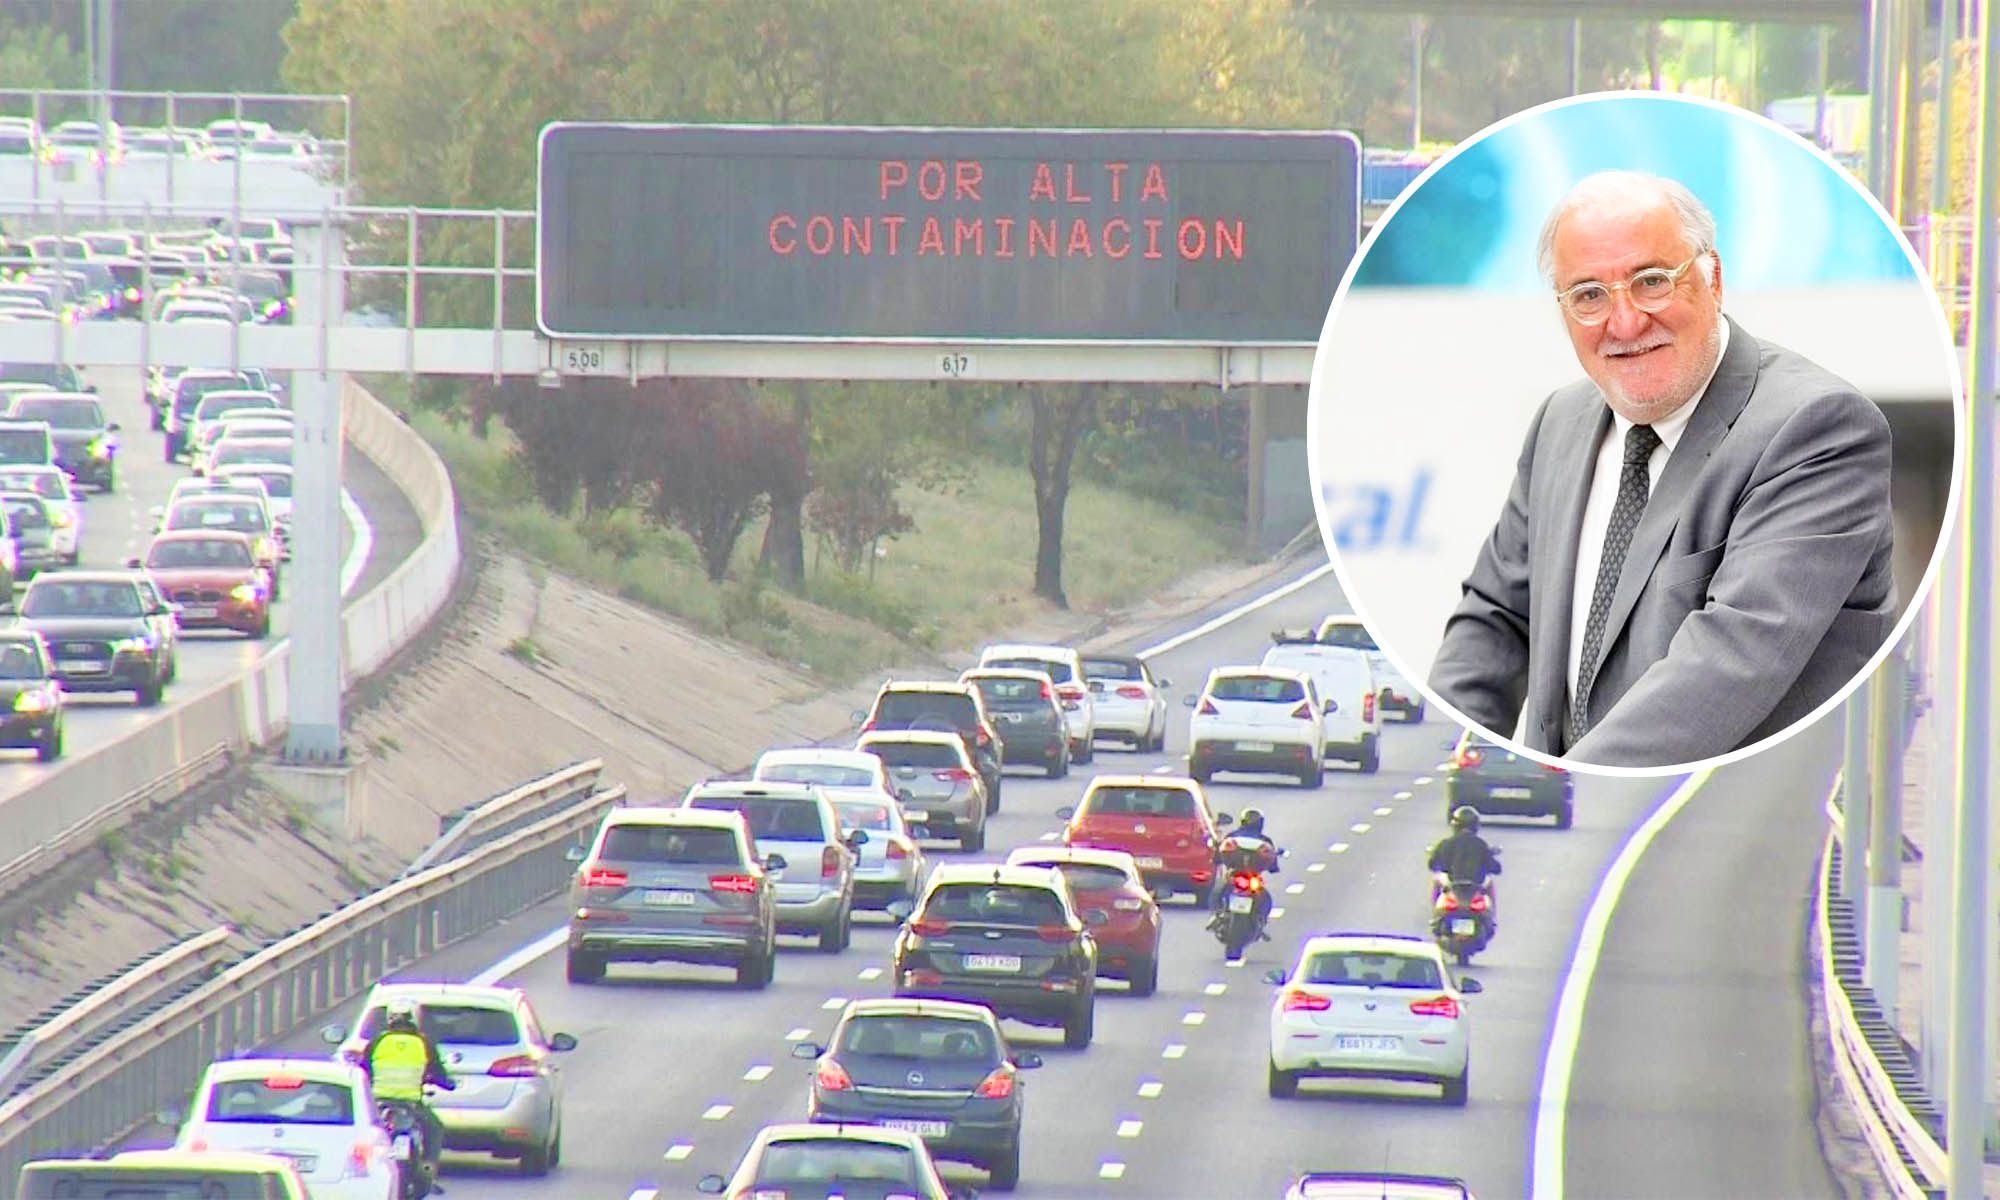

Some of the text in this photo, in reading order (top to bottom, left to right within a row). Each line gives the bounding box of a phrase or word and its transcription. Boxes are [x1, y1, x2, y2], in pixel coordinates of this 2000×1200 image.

[879, 160, 1168, 203] POR ALTA
[768, 215, 1244, 260] CONTAMINACION
